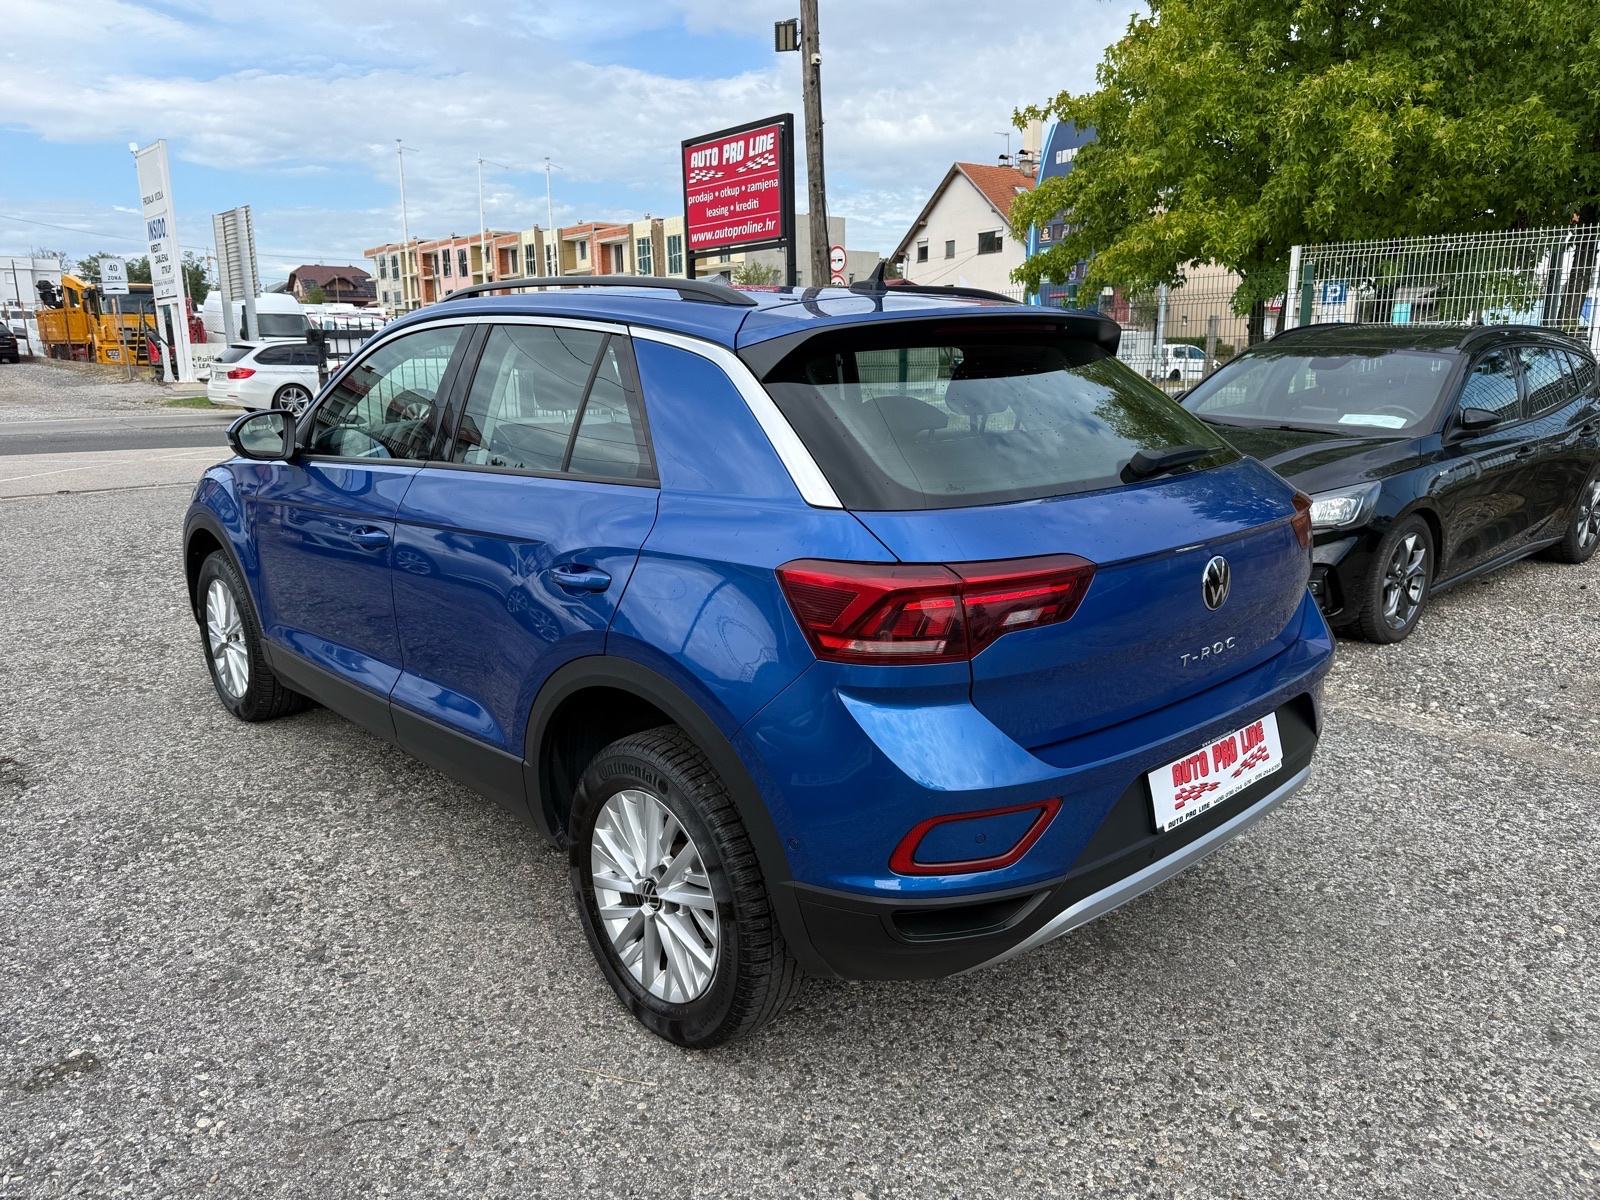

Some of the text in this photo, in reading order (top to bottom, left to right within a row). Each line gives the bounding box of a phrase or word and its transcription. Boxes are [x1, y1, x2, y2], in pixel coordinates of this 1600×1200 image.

[690, 132, 775, 168] AUTO PRO LINE
[688, 178, 779, 206] prodaja otkup zamjena
[706, 198, 760, 218] leasing krediti
[691, 218, 777, 243] www.autoproline.hr
[108, 264, 118, 272] 40
[1180, 636, 1236, 668] T-ROC
[1171, 720, 1265, 788] AUTO PRO LINE
[1168, 816, 1184, 829] AUTO
[1185, 809, 1197, 820] PRO
[1198, 801, 1210, 813] LINE
